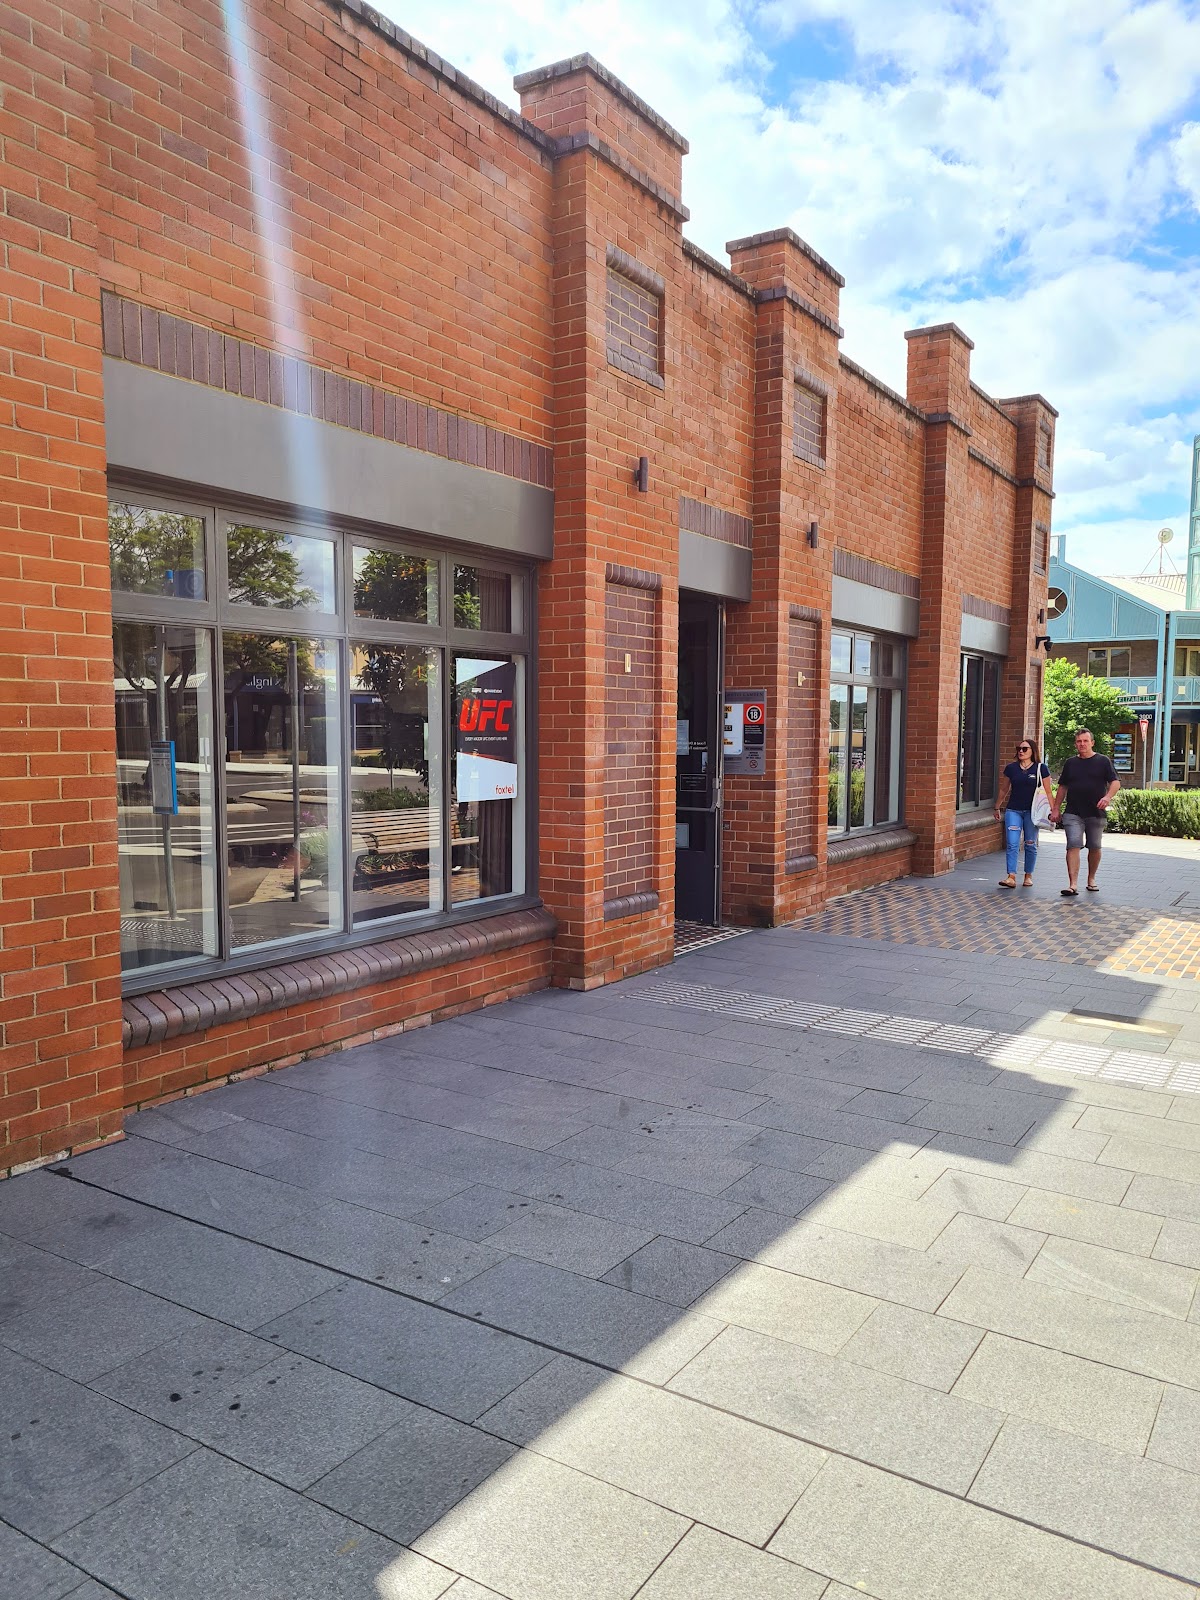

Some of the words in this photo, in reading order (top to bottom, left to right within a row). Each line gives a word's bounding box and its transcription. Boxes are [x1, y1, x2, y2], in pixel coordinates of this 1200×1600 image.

[459, 698, 513, 732] UFC
[750, 711, 758, 720] 18
[495, 784, 515, 795] foxtel
